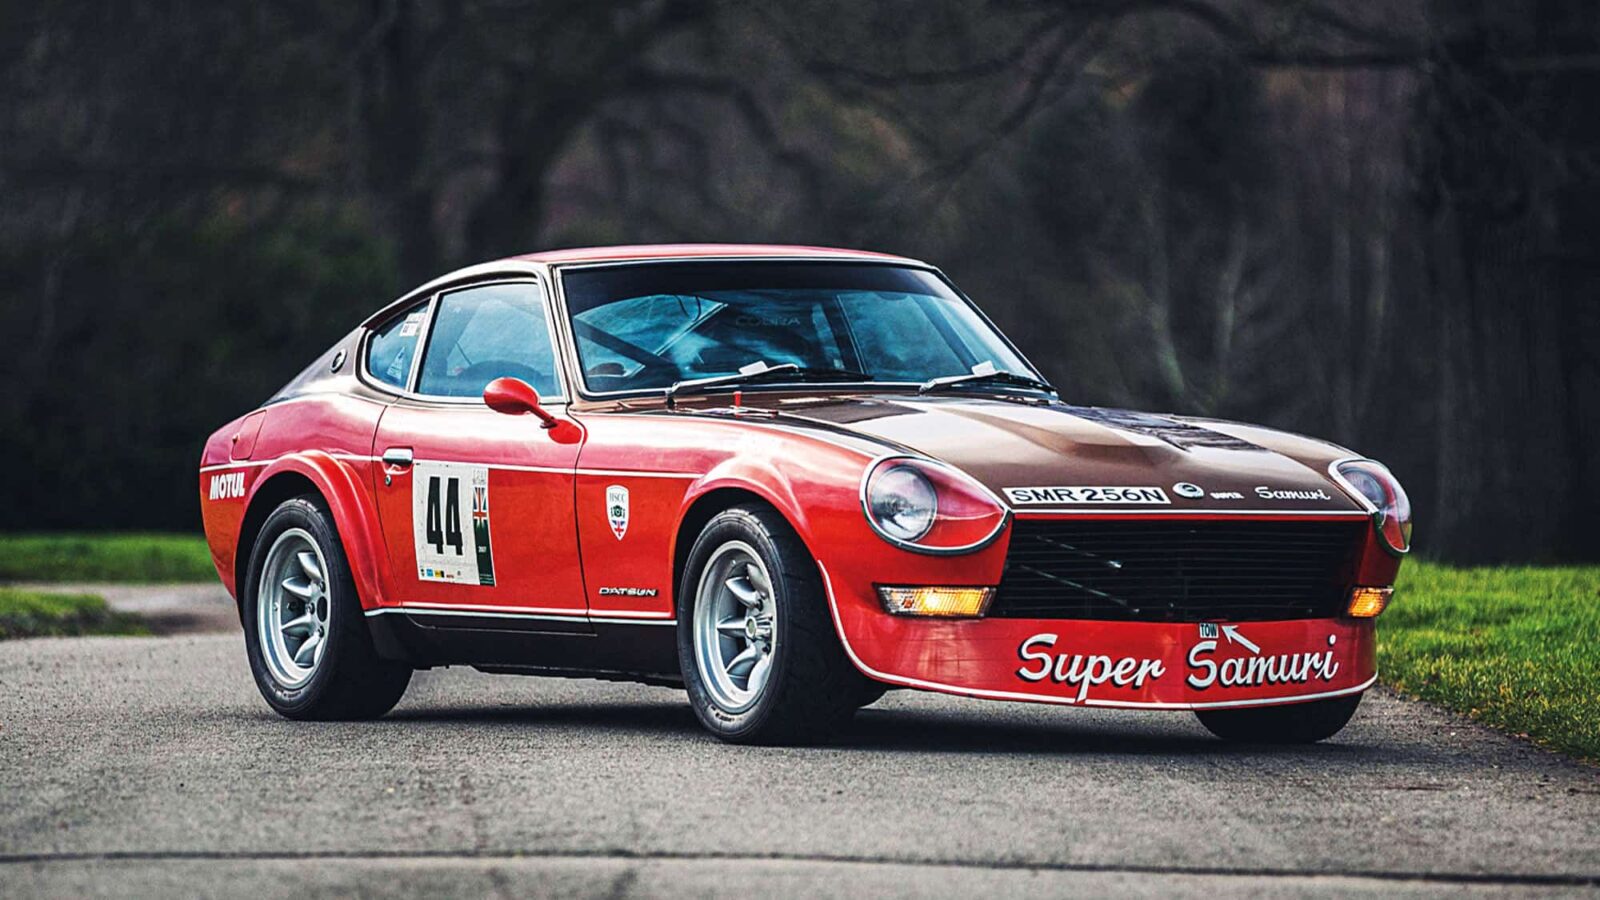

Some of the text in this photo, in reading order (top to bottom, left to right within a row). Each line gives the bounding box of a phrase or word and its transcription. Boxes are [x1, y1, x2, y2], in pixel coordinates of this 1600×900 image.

[209, 472, 245, 500] MOTUL
[1254, 486, 1331, 500] Samuri
[1011, 488, 1166, 502] SMR 256N
[426, 476, 463, 556] 44
[599, 587, 658, 597] DATSUN
[1200, 623, 1217, 637] TOW
[1017, 633, 1339, 703] Super Samuri
